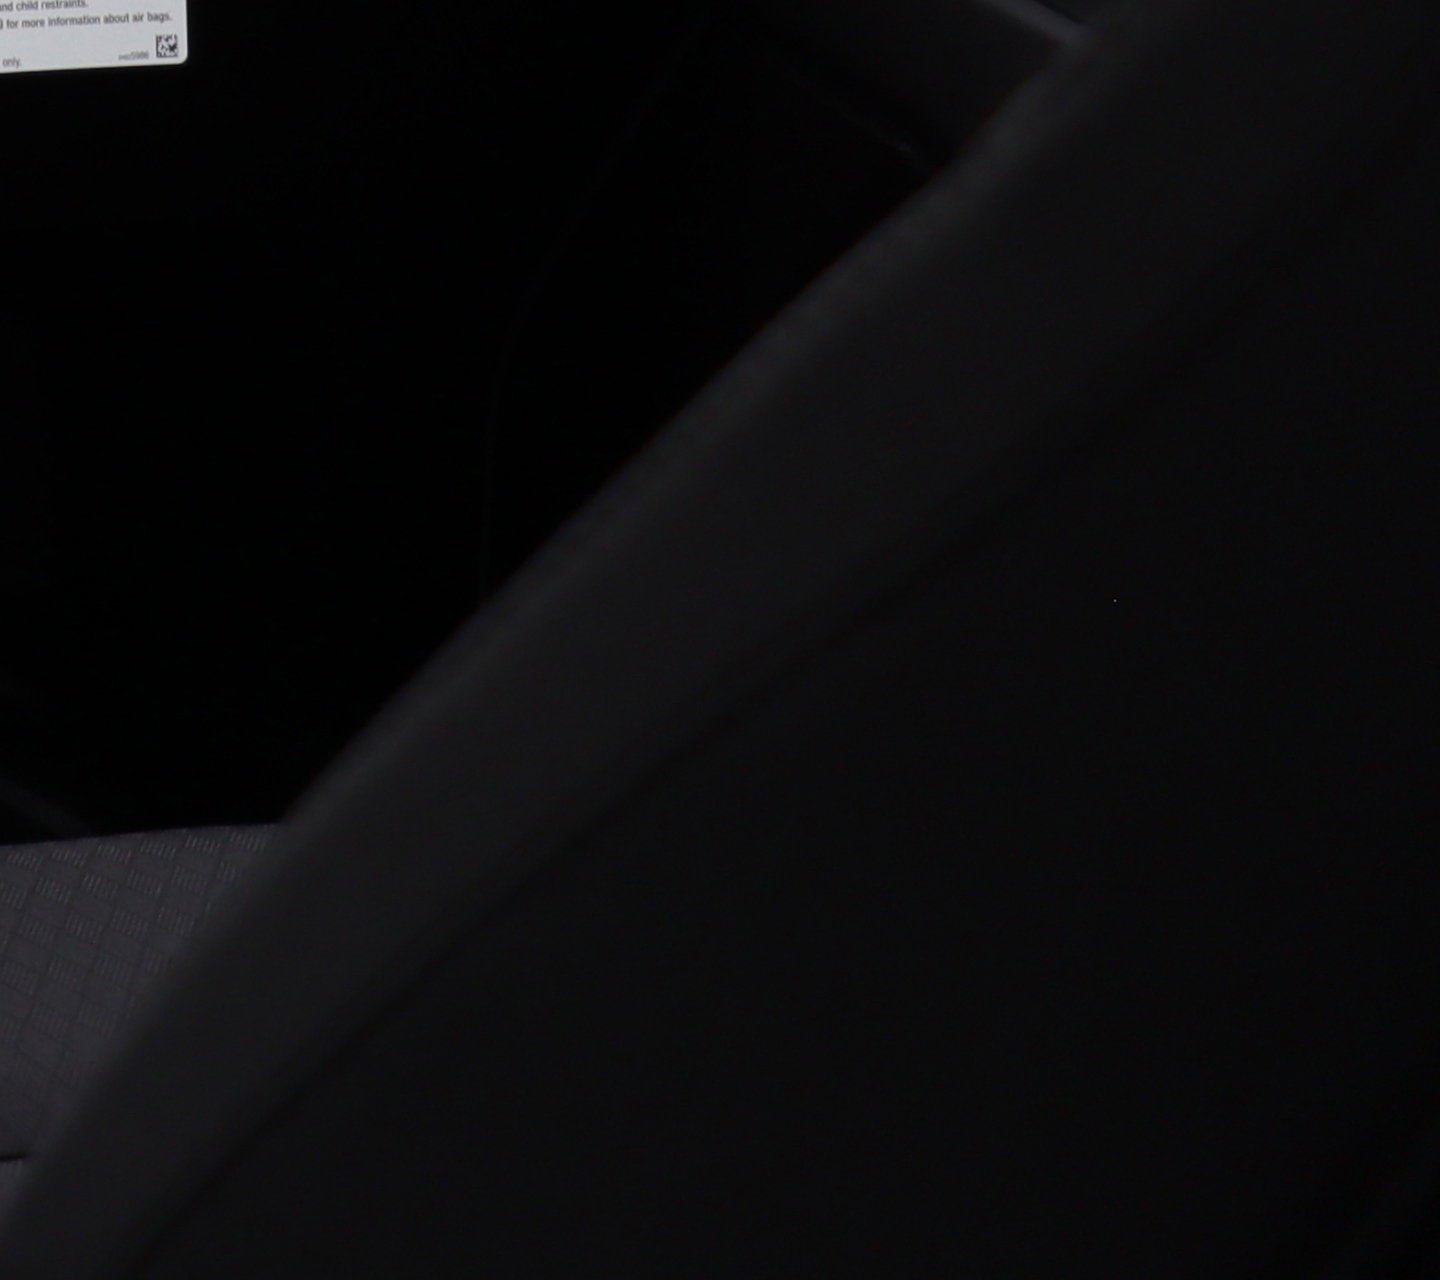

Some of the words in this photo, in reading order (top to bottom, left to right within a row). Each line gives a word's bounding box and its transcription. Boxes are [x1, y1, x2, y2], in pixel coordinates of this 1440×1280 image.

[16, 0, 39, 11] child
[6, 19, 19, 29] for
[21, 19, 45, 28] more
[48, 14, 101, 26] information
[103, 13, 130, 24] about
[132, 12, 144, 22] air
[147, 11, 173, 23] bags.
[2, 56, 22, 69] only.
